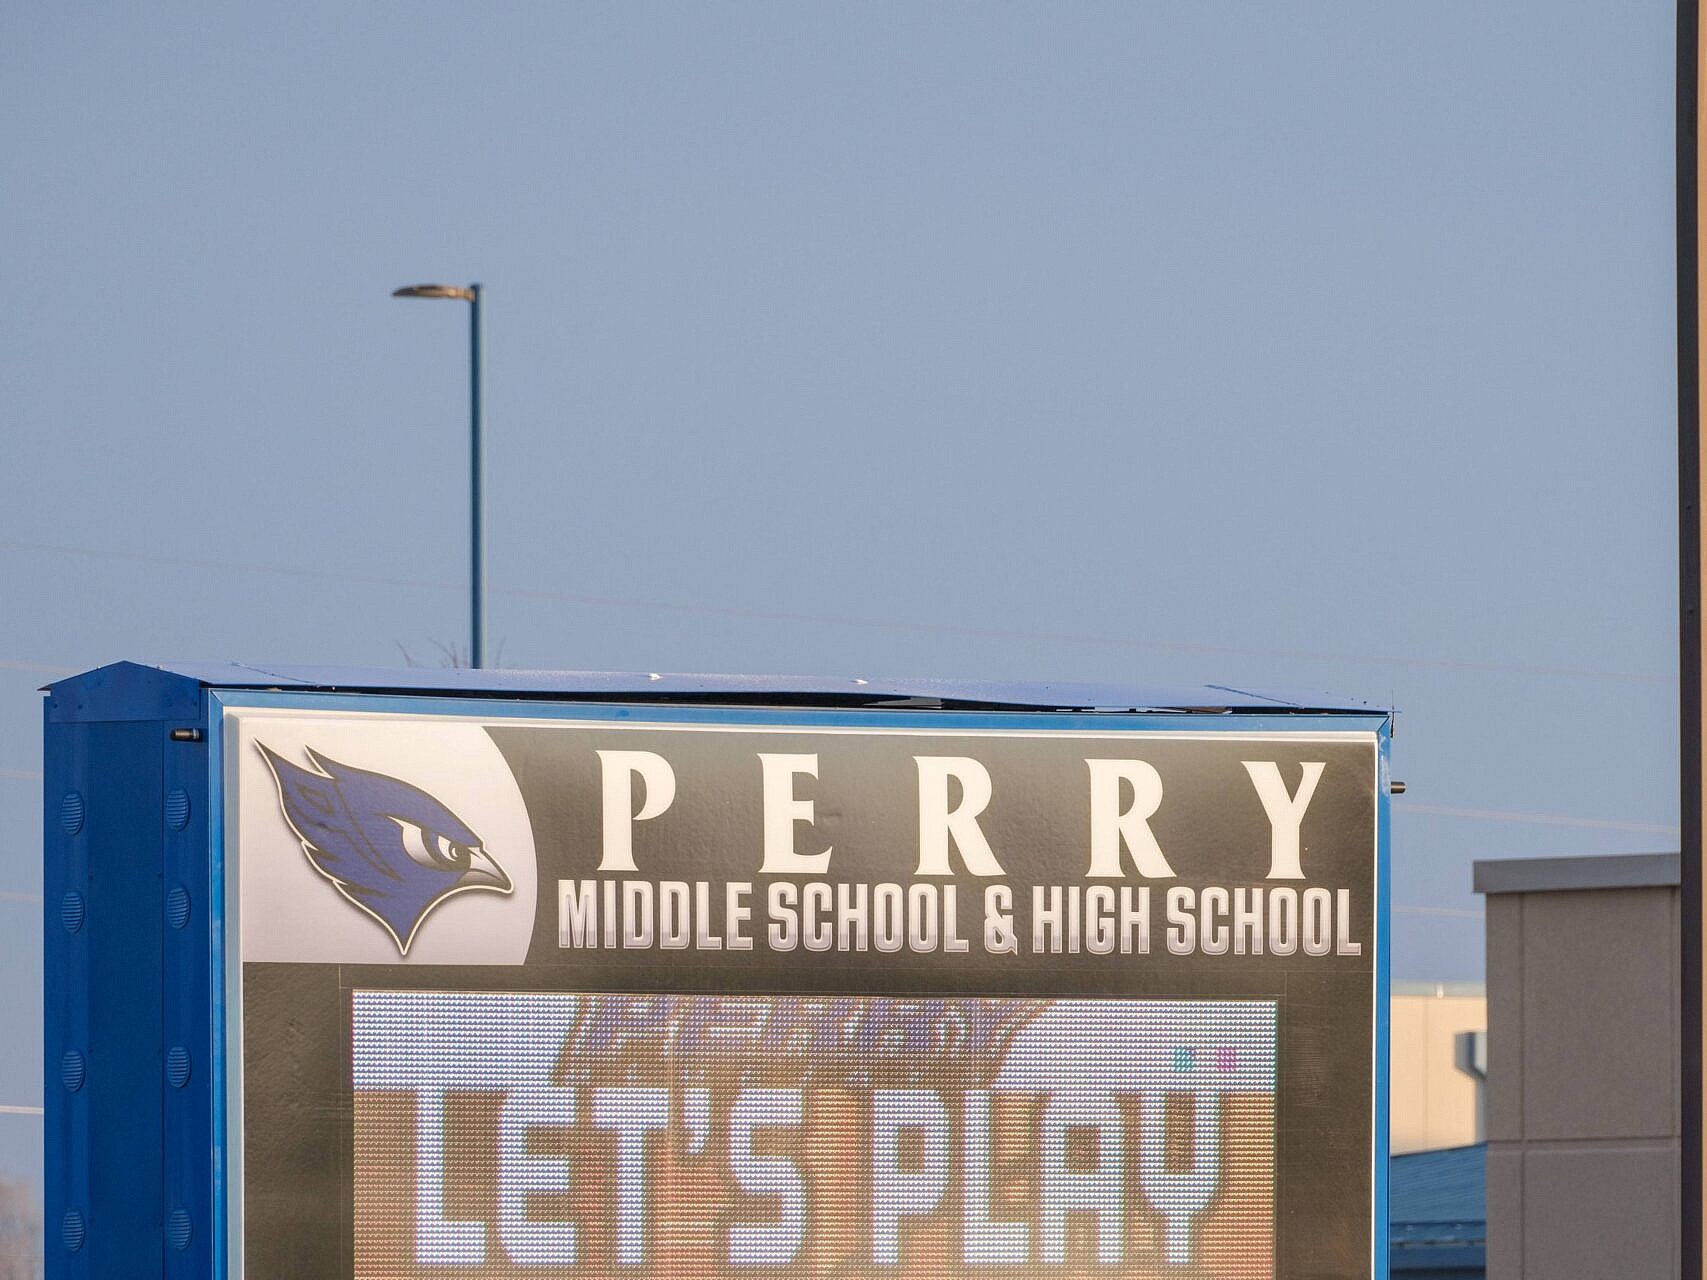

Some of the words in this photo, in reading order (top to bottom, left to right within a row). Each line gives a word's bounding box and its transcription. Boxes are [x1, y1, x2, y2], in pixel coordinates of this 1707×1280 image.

[595, 749, 1327, 880] PERRY
[557, 879, 753, 950] MIDDLE
[768, 881, 969, 954] SCHOOL
[984, 884, 1018, 956] &
[1032, 885, 1151, 955] HIGH
[1166, 887, 1362, 957] SCHOOL
[415, 1087, 807, 1266] LET'S
[872, 1088, 1221, 1266] PLAY
